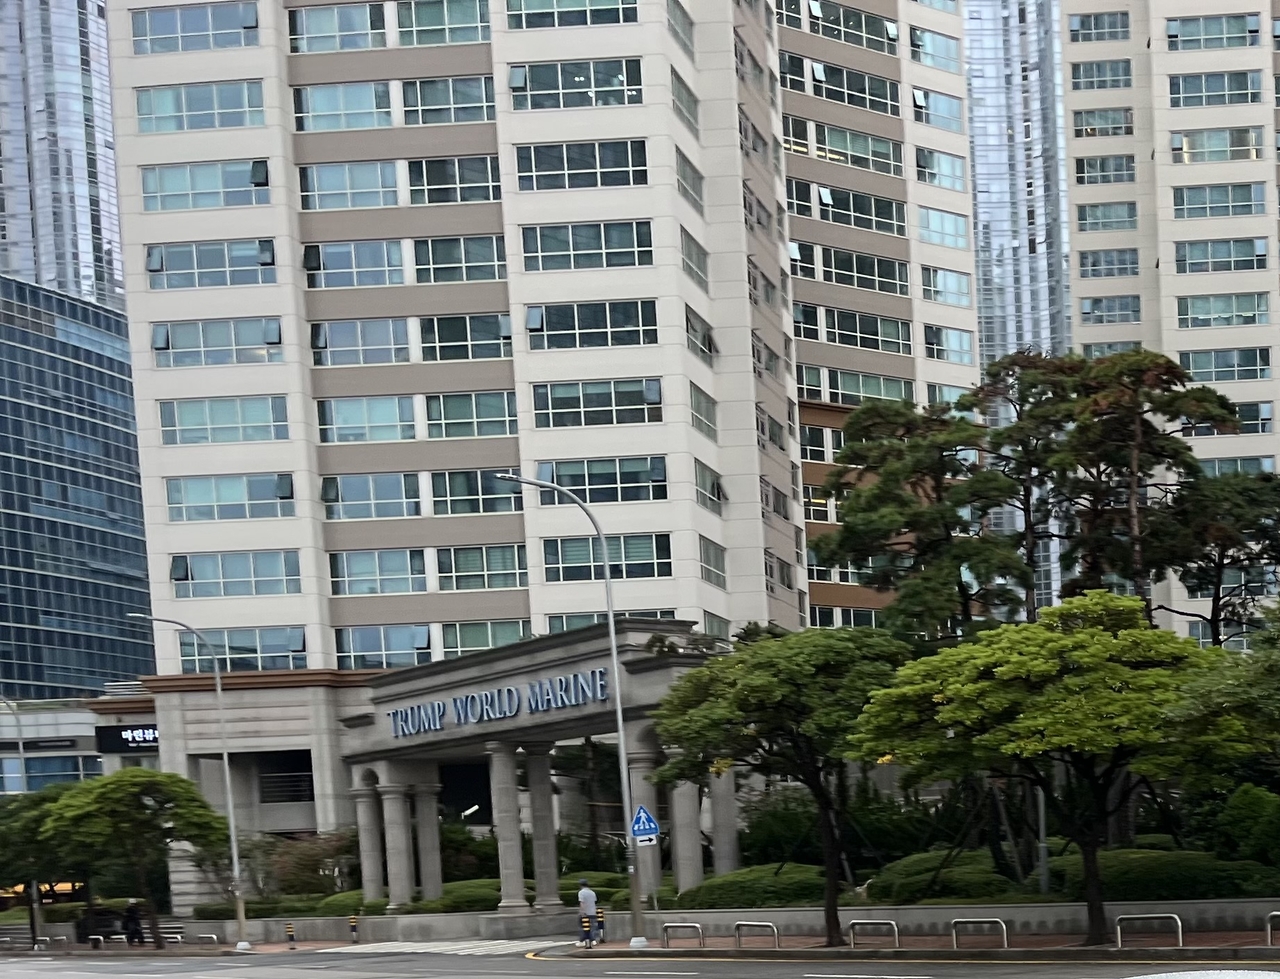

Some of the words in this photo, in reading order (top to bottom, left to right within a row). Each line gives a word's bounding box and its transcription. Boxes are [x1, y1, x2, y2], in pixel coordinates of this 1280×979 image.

[387, 701, 446, 737] TRUMP
[452, 686, 520, 725] WORLD
[528, 667, 608, 713] MARINE
[121, 729, 159, 741] 마린뷰
